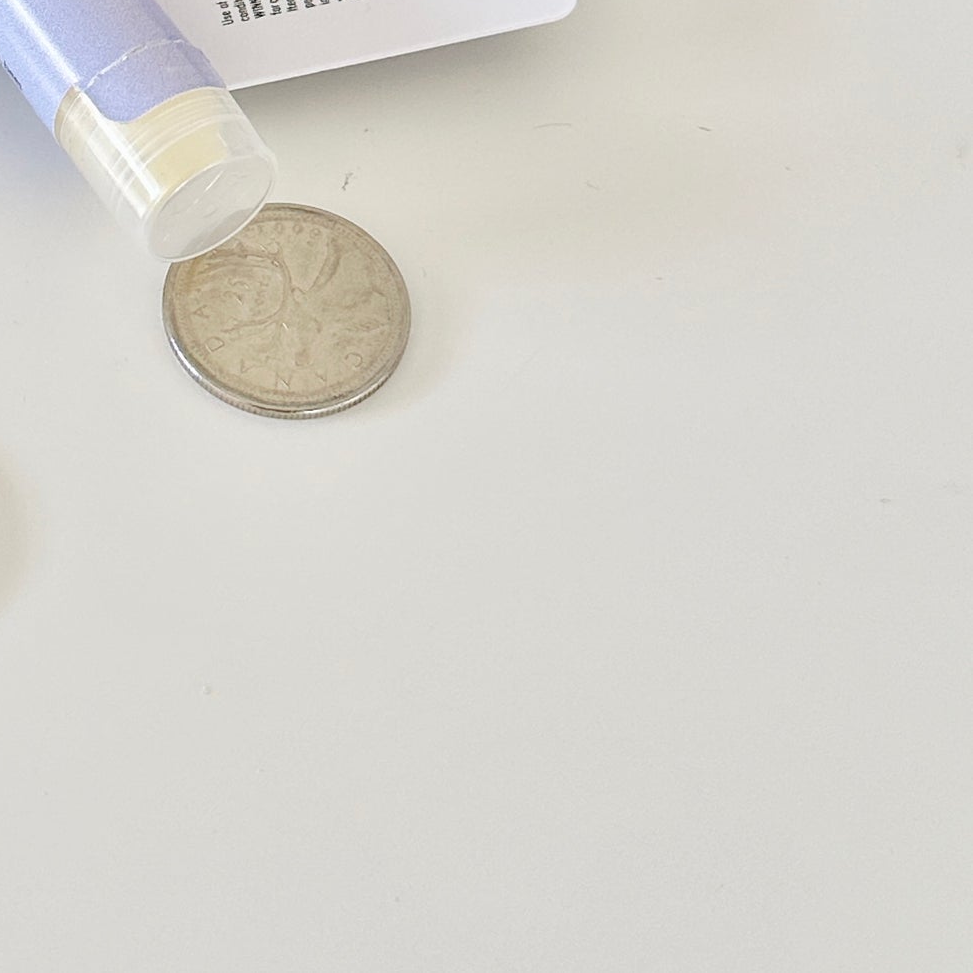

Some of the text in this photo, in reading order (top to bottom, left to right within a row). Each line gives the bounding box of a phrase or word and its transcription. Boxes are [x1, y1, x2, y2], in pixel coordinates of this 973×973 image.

[215, 0, 229, 9] of
[269, 4, 282, 16] for
[221, 10, 234, 26] Use
